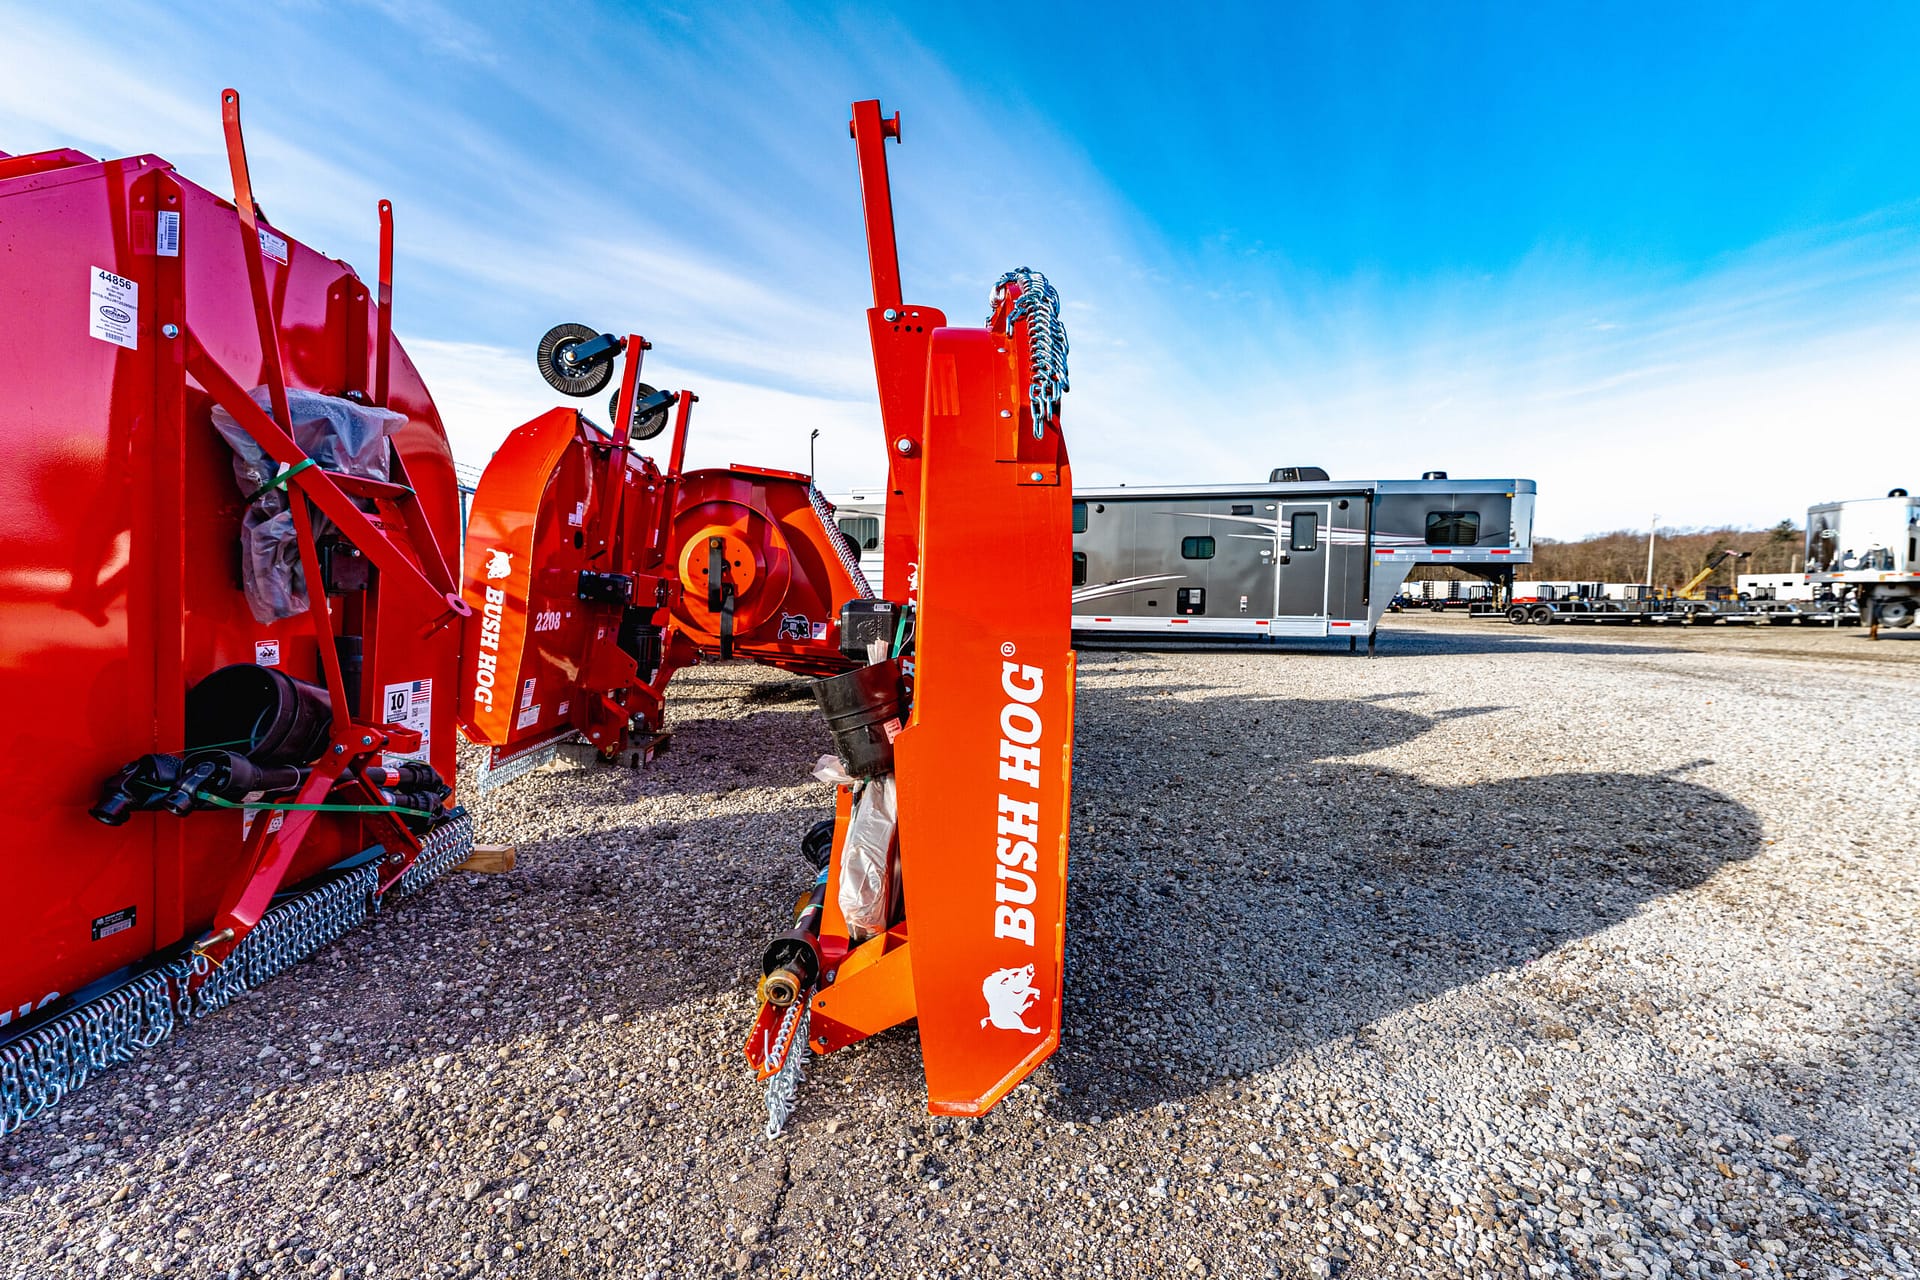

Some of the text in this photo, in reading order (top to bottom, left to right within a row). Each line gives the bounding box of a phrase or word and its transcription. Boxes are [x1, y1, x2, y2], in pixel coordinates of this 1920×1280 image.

[98, 271, 132, 290] 44856
[480, 585, 504, 651] BUSH
[534, 611, 561, 632] 2208
[391, 692, 404, 711] 10
[994, 793, 1039, 947] BUSH
